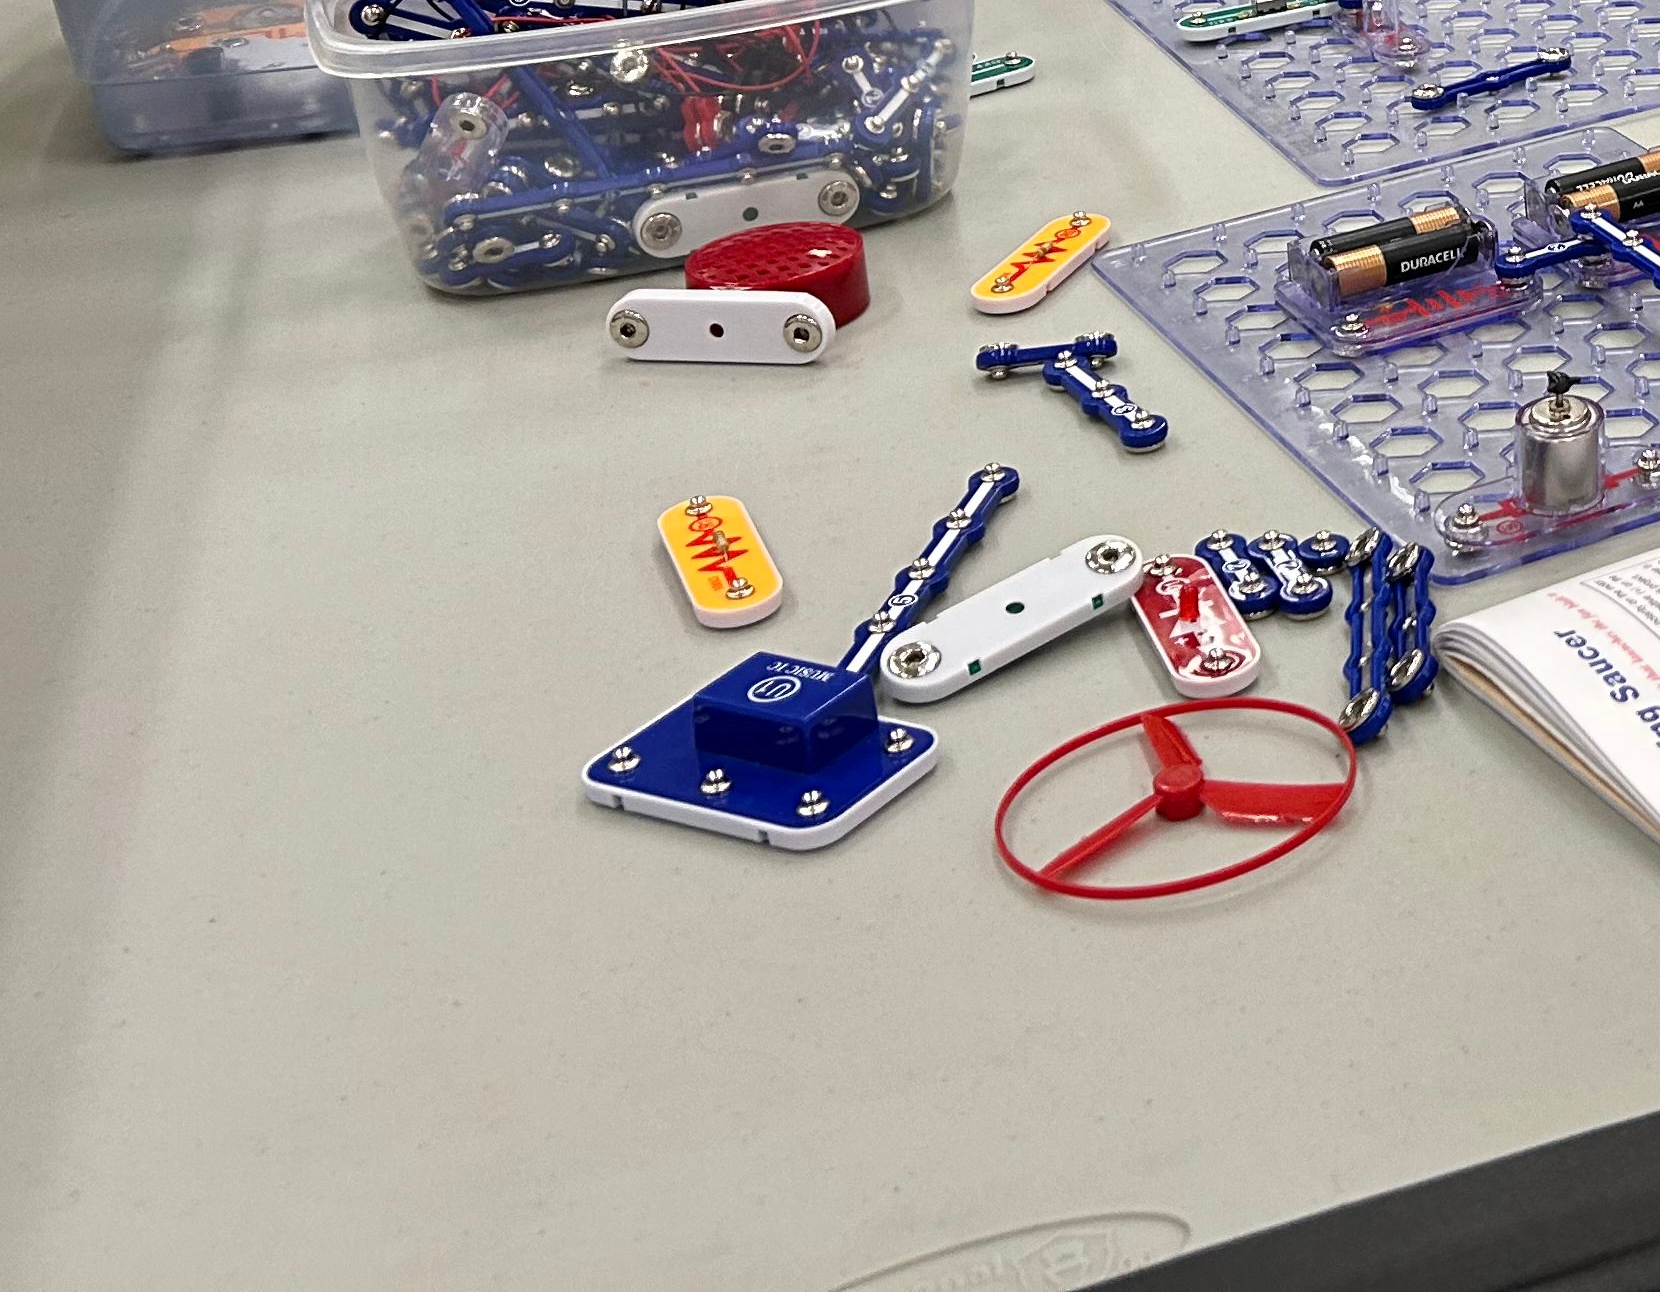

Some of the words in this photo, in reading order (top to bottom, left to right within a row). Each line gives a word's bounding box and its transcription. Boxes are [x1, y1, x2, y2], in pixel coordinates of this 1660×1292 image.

[1400, 246, 1464, 274] DURACELL
[784, 664, 836, 683] MUSIC
[1554, 630, 1639, 702] Saucer
[753, 679, 792, 698] U1
